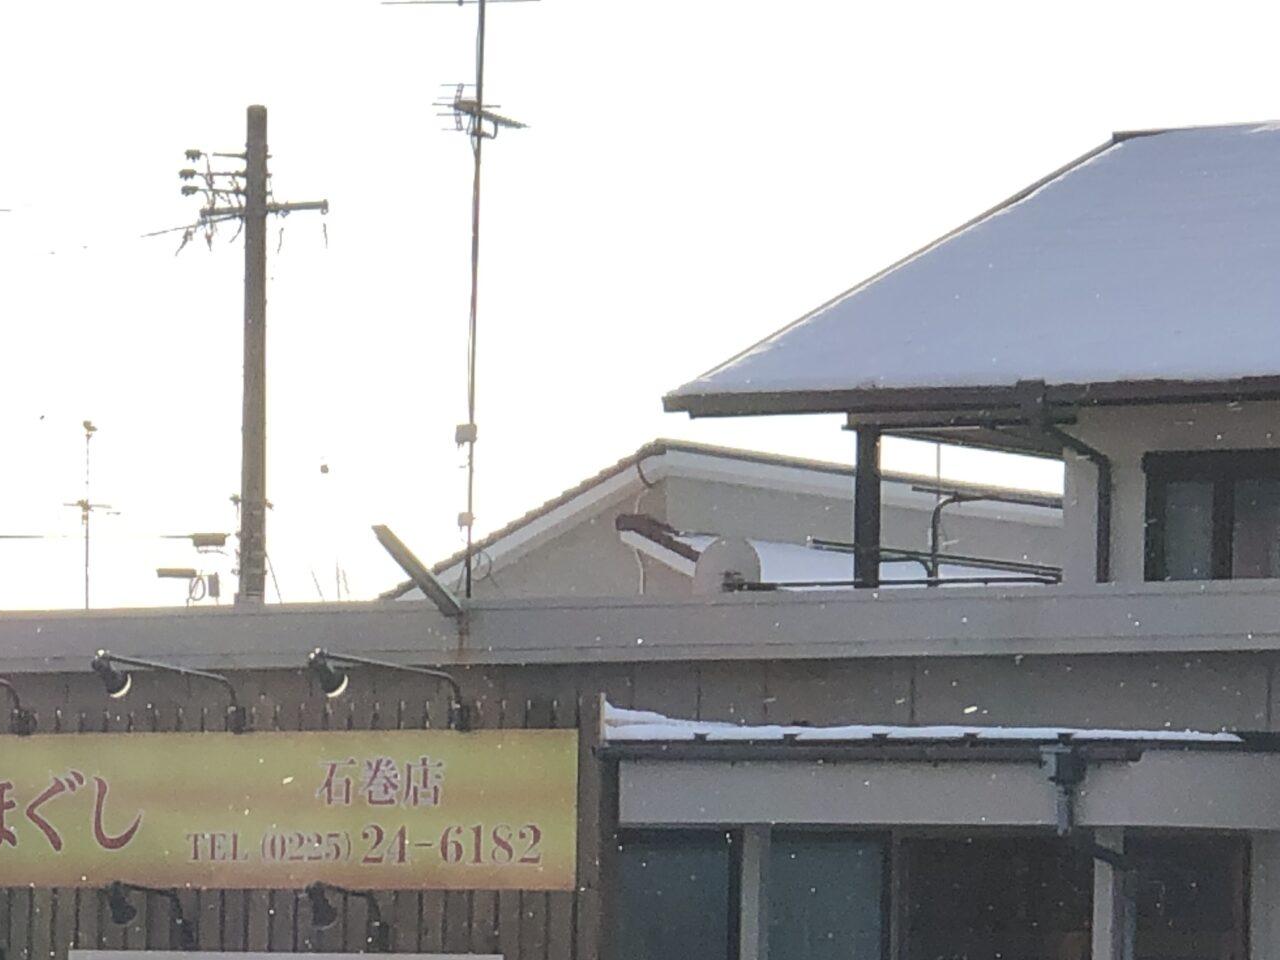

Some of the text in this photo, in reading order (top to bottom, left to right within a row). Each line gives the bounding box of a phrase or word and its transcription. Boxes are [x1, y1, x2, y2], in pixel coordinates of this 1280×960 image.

[317, 756, 445, 806] 石巻店
[186, 823, 543, 865] TEL (0225) 24-6182
